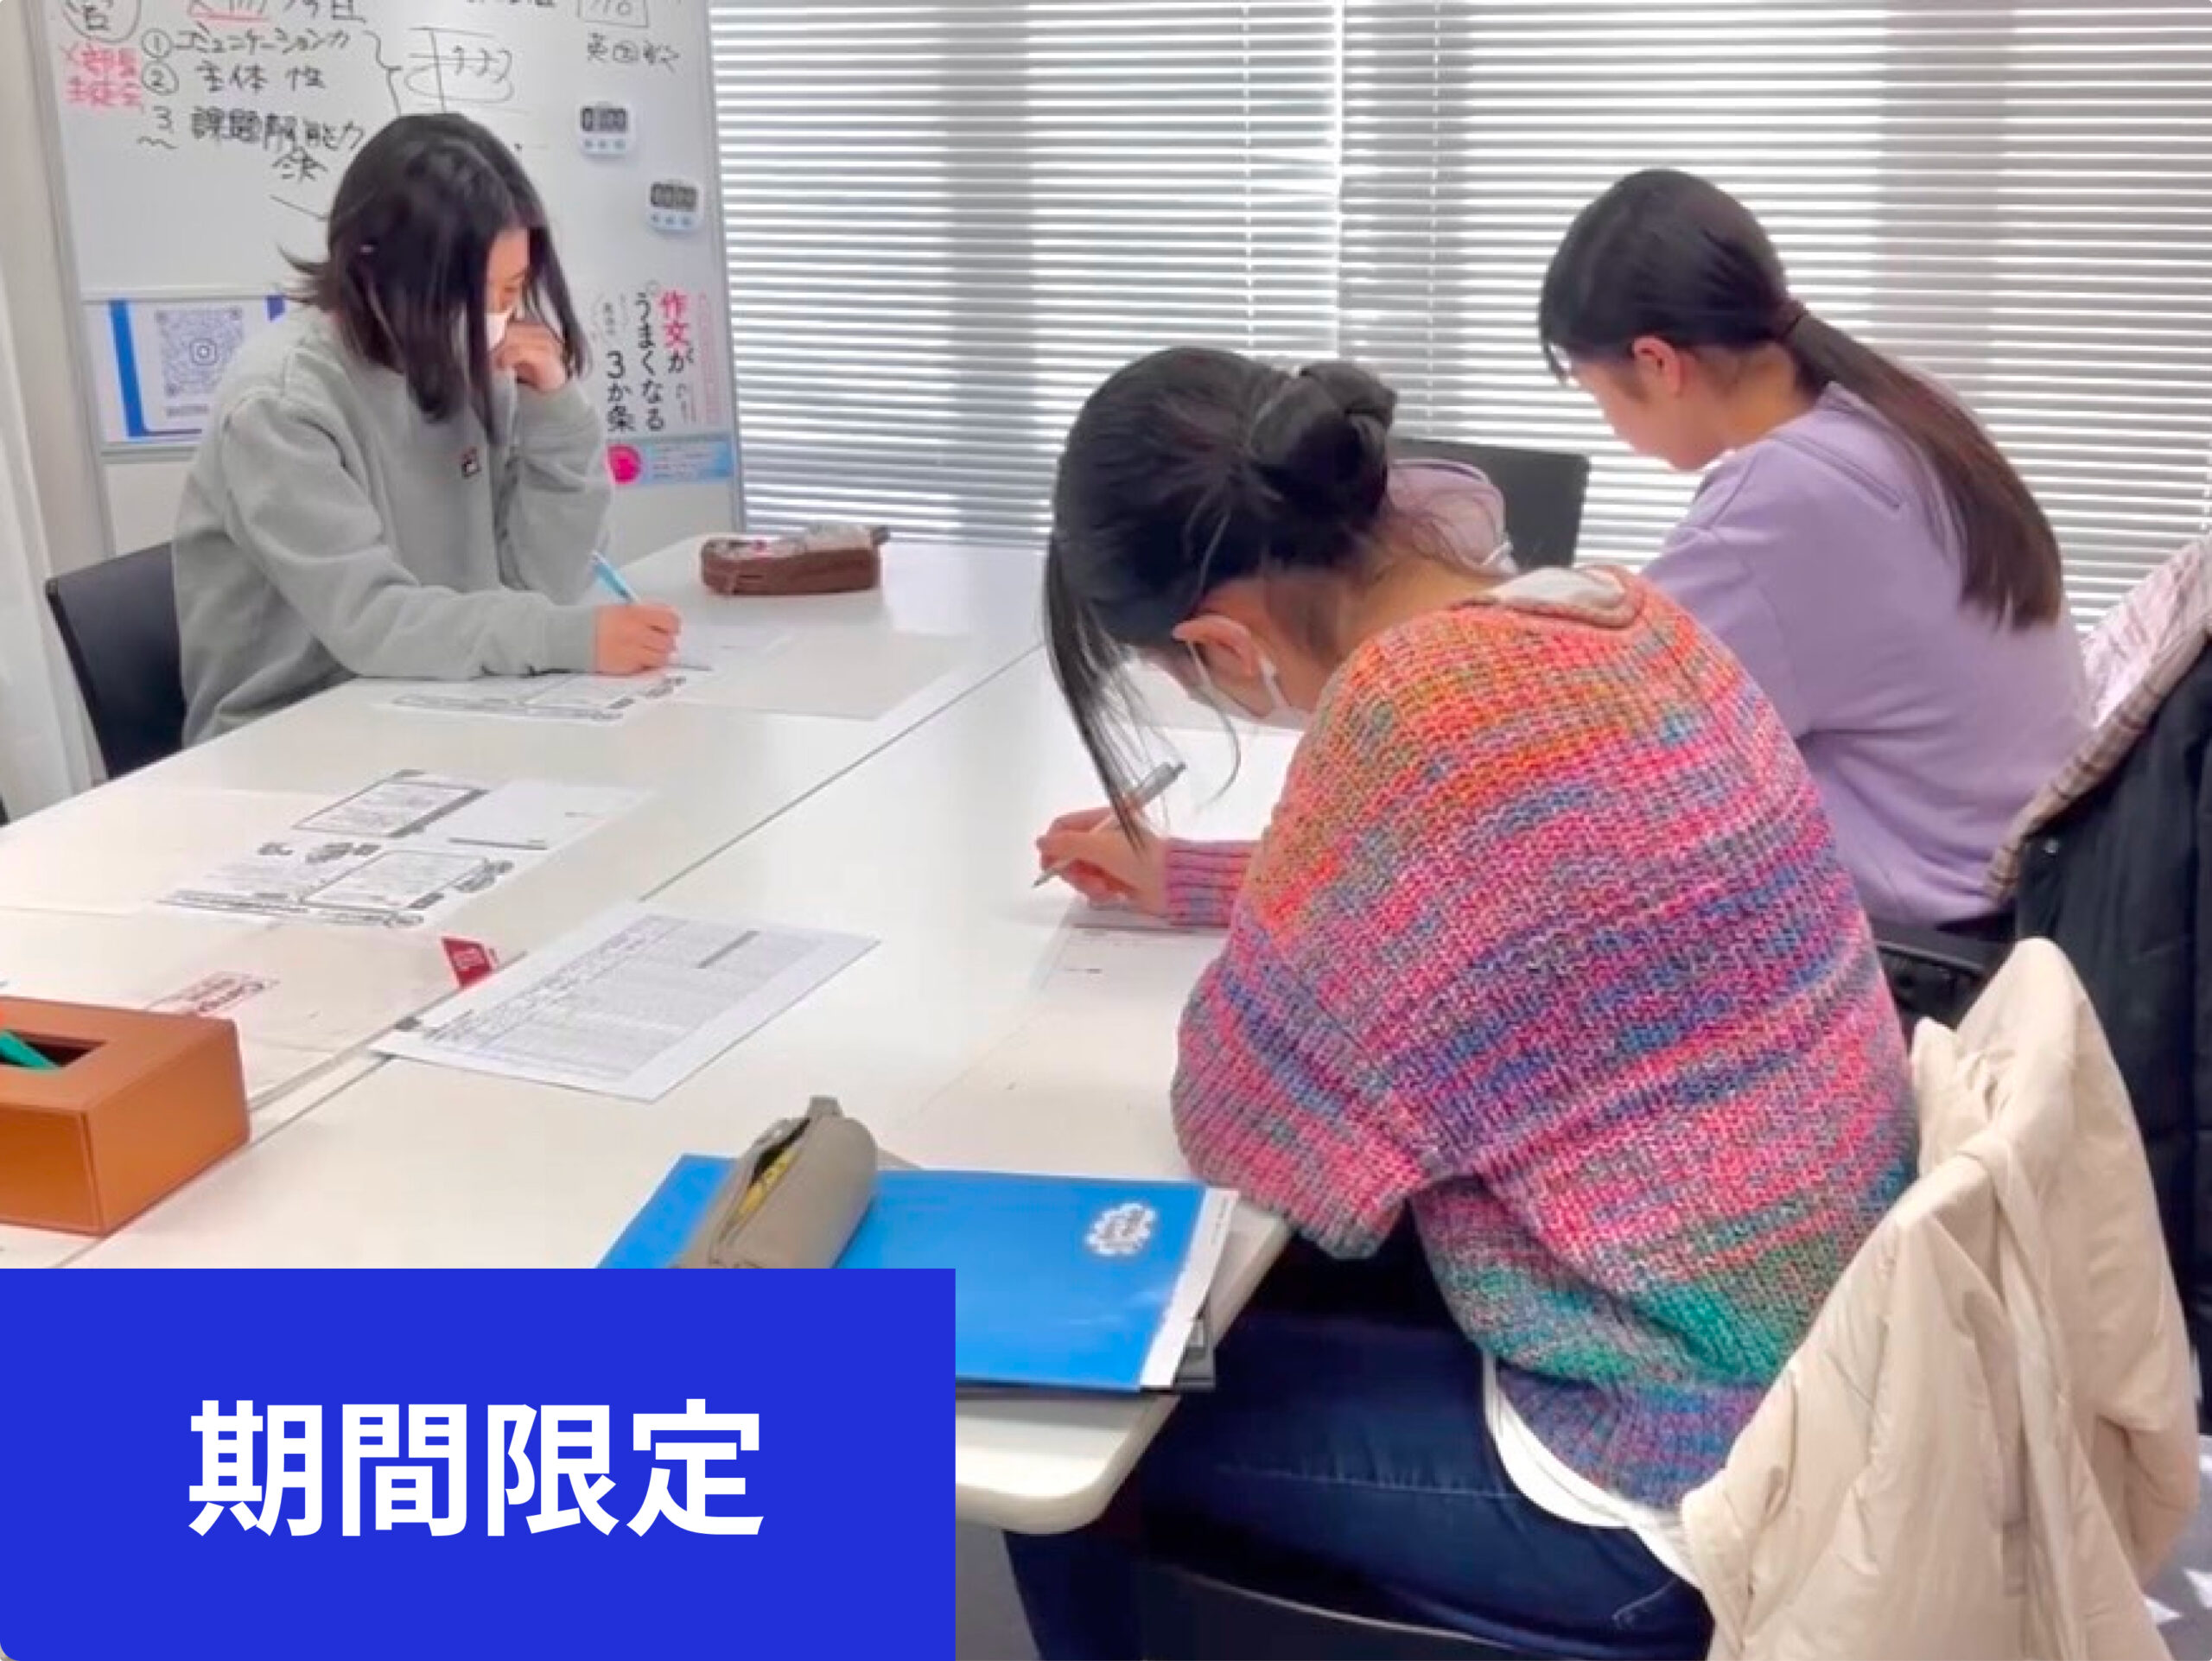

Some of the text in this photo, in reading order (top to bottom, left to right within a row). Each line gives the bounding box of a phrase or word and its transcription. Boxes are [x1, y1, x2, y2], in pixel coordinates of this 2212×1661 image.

[635, 291, 664, 432] うまくなる
[658, 289, 694, 374] 作文が
